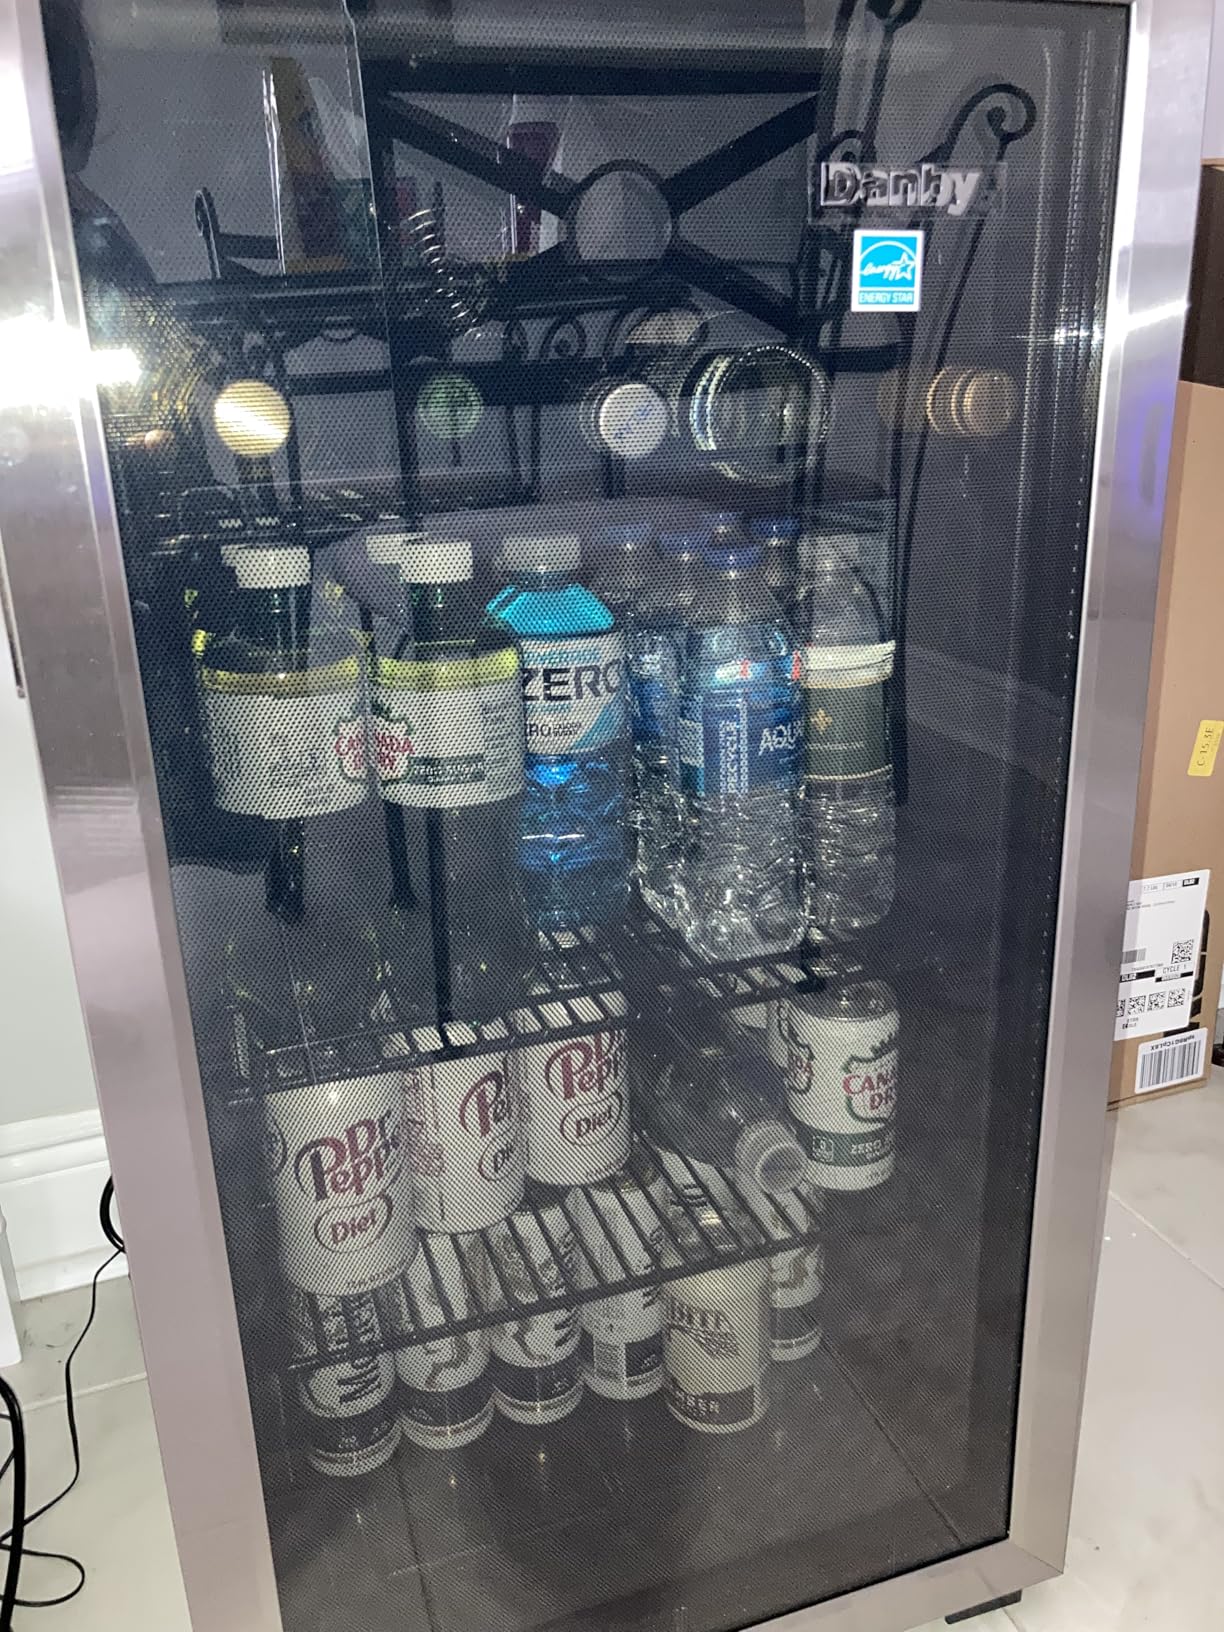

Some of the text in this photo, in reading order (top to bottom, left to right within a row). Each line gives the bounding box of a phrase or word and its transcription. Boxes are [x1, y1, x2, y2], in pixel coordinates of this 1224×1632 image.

[820, 161, 982, 216] Danby
[859, 292, 913, 303] ENERGY STAR
[521, 658, 622, 701] ZERO
[575, 1106, 615, 1138] Diet
[330, 1208, 379, 1244] Diet
